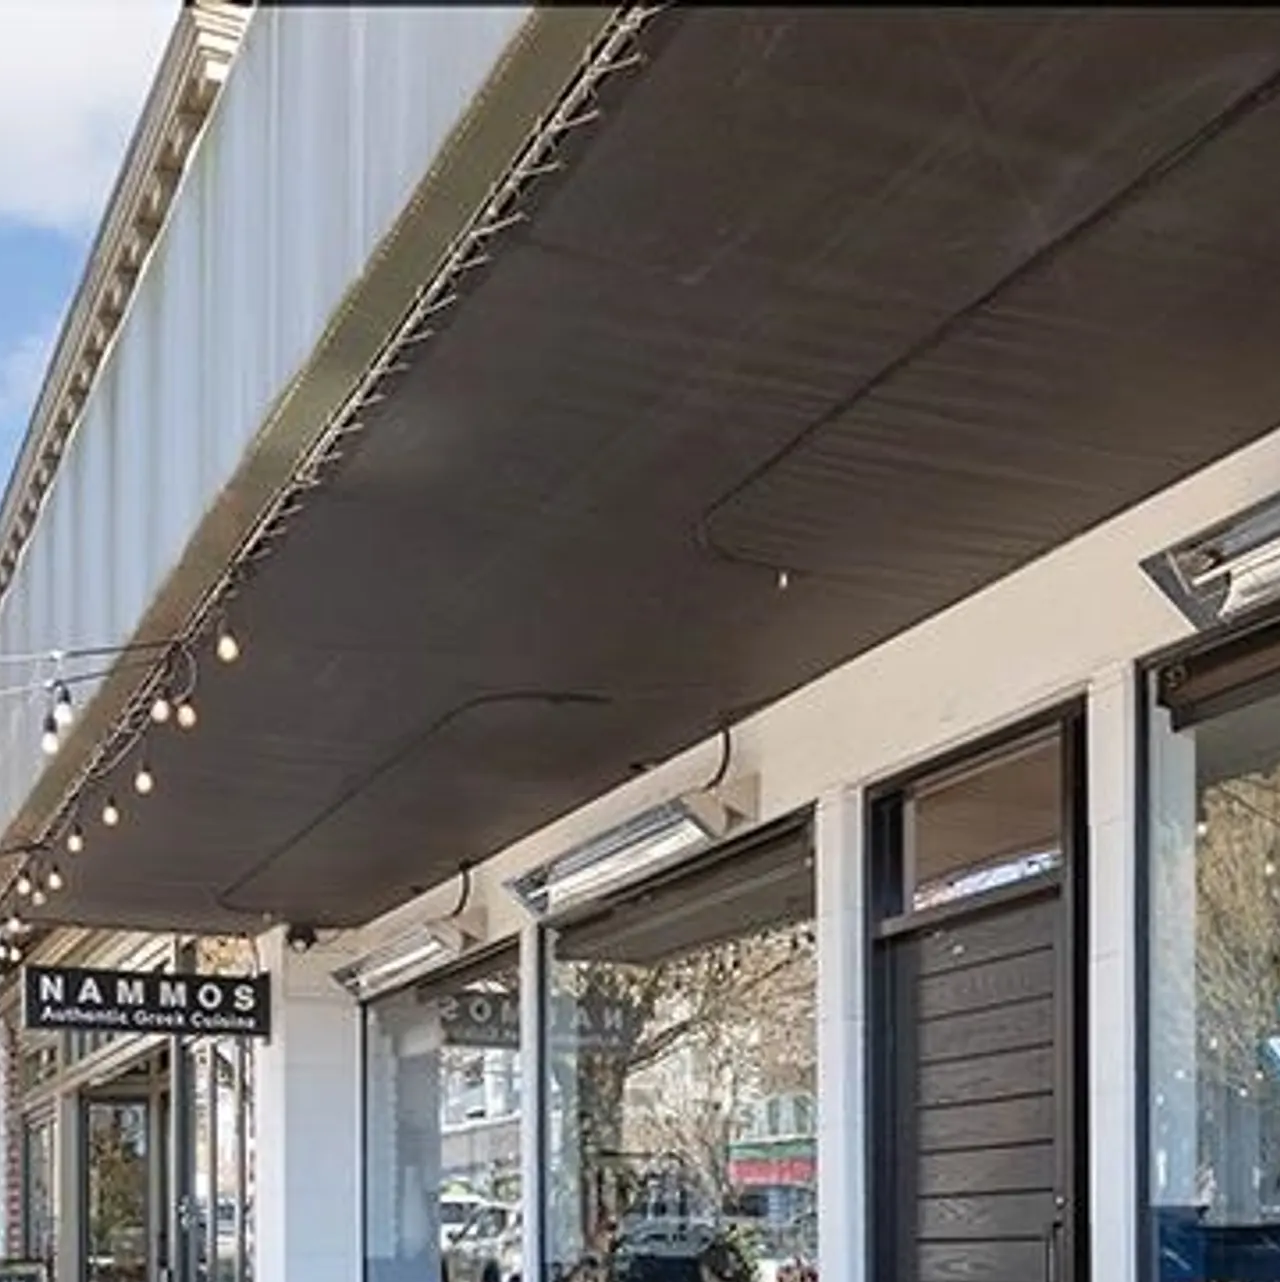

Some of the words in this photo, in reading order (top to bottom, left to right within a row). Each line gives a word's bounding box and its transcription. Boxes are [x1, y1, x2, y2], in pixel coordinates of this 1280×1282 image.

[38, 973, 256, 1011] NAMMOS
[41, 1005, 128, 1025] Authentic
[133, 1009, 184, 1026] Greek
[190, 1011, 256, 1029] Cuisine
